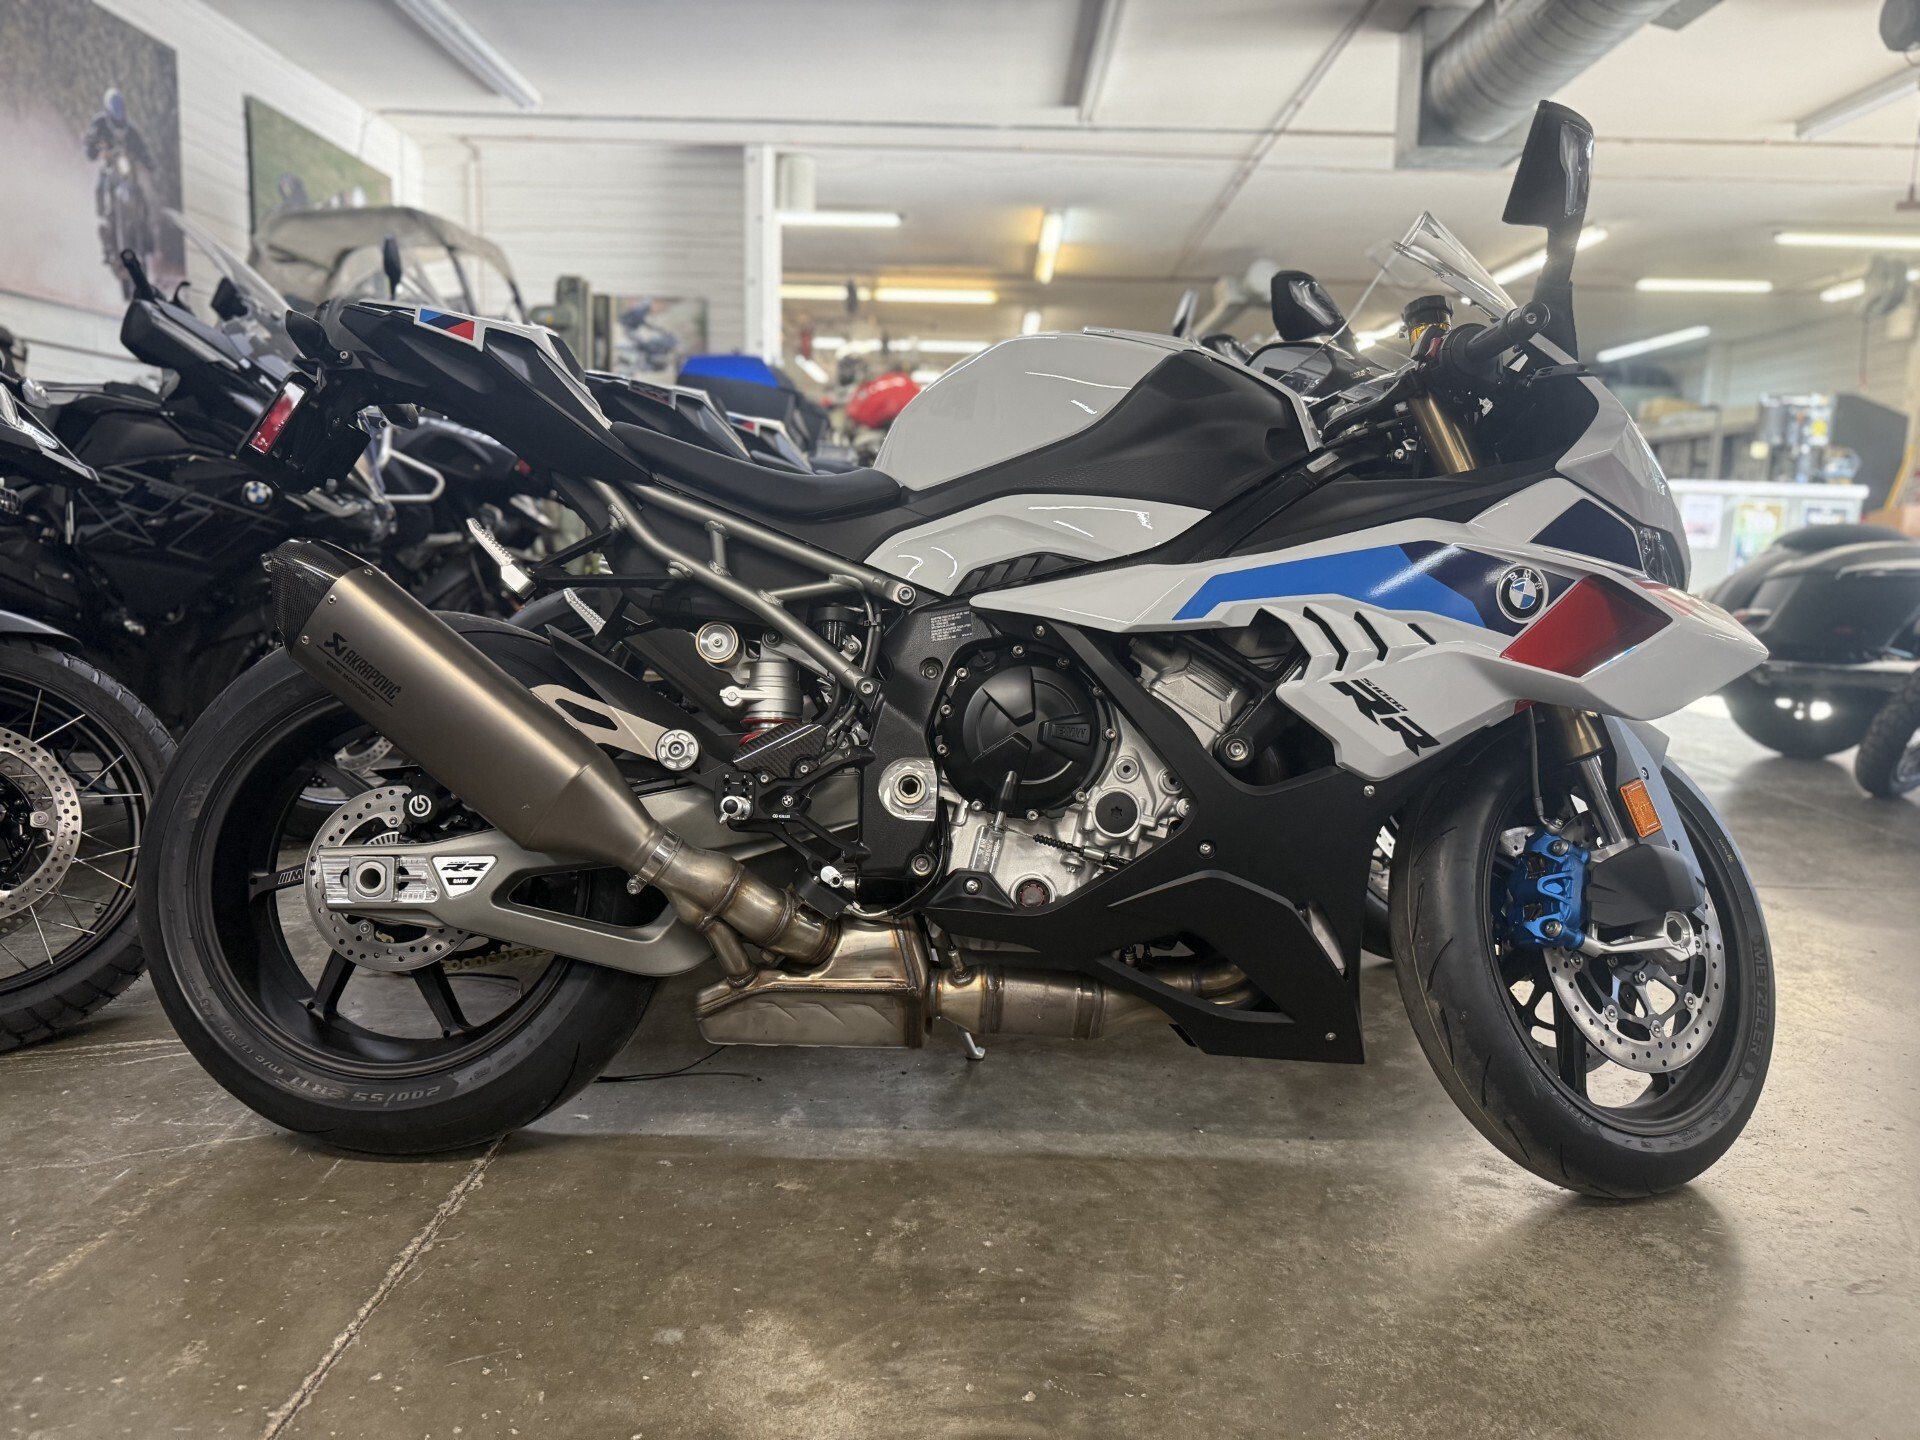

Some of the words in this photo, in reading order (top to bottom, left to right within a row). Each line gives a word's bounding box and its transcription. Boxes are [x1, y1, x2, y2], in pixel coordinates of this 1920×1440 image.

[1510, 569, 1543, 590] BMW
[1330, 680, 1441, 756] RR
[1059, 727, 1087, 738] BMW
[441, 862, 488, 872] RR
[1752, 950, 1768, 1056] METZELER
[351, 1086, 441, 1106] 200/55
